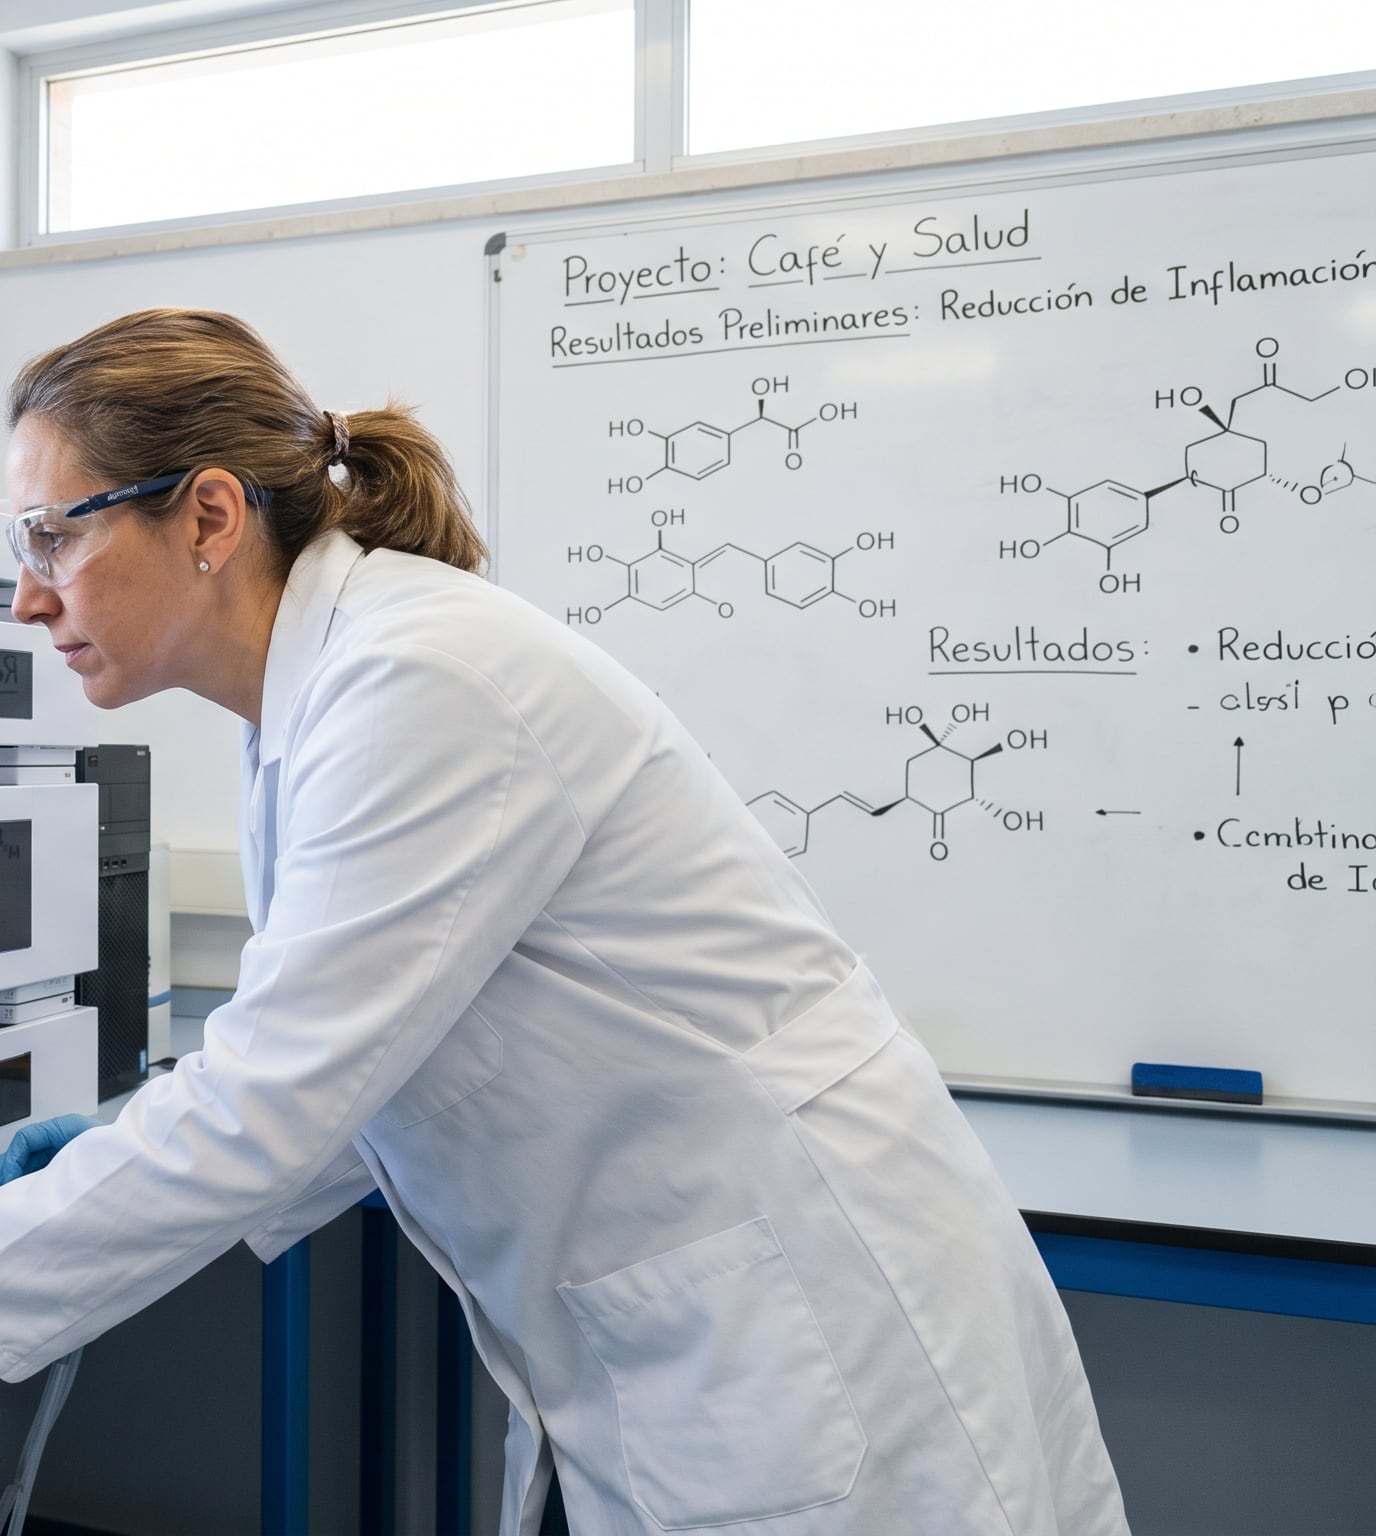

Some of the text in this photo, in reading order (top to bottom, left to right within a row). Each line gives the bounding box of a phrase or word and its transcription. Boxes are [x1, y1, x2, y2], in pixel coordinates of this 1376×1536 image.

[563, 208, 1029, 306] Proyecto: Café y Salud
[550, 250, 1376, 358] Resultados Preliminares: Reducción de Inflamación
[751, 375, 789, 395] OH
[1155, 386, 1203, 409] HO
[819, 401, 858, 421] OH
[608, 419, 644, 437] HO
[608, 475, 643, 494] HO
[1000, 474, 1042, 494] HO
[651, 508, 685, 526] OH
[856, 532, 894, 551] OH
[1000, 539, 1041, 559] HO
[568, 544, 604, 563] HO
[1099, 573, 1141, 594] OH
[567, 606, 602, 625] HO
[859, 599, 896, 618] OH
[929, 626, 1149, 663] Resultados:
[886, 706, 924, 726] HO
[951, 703, 989, 723] OH
[1007, 729, 1048, 750] OH
[1003, 811, 1044, 832] OH
[1287, 862, 1327, 891] de
